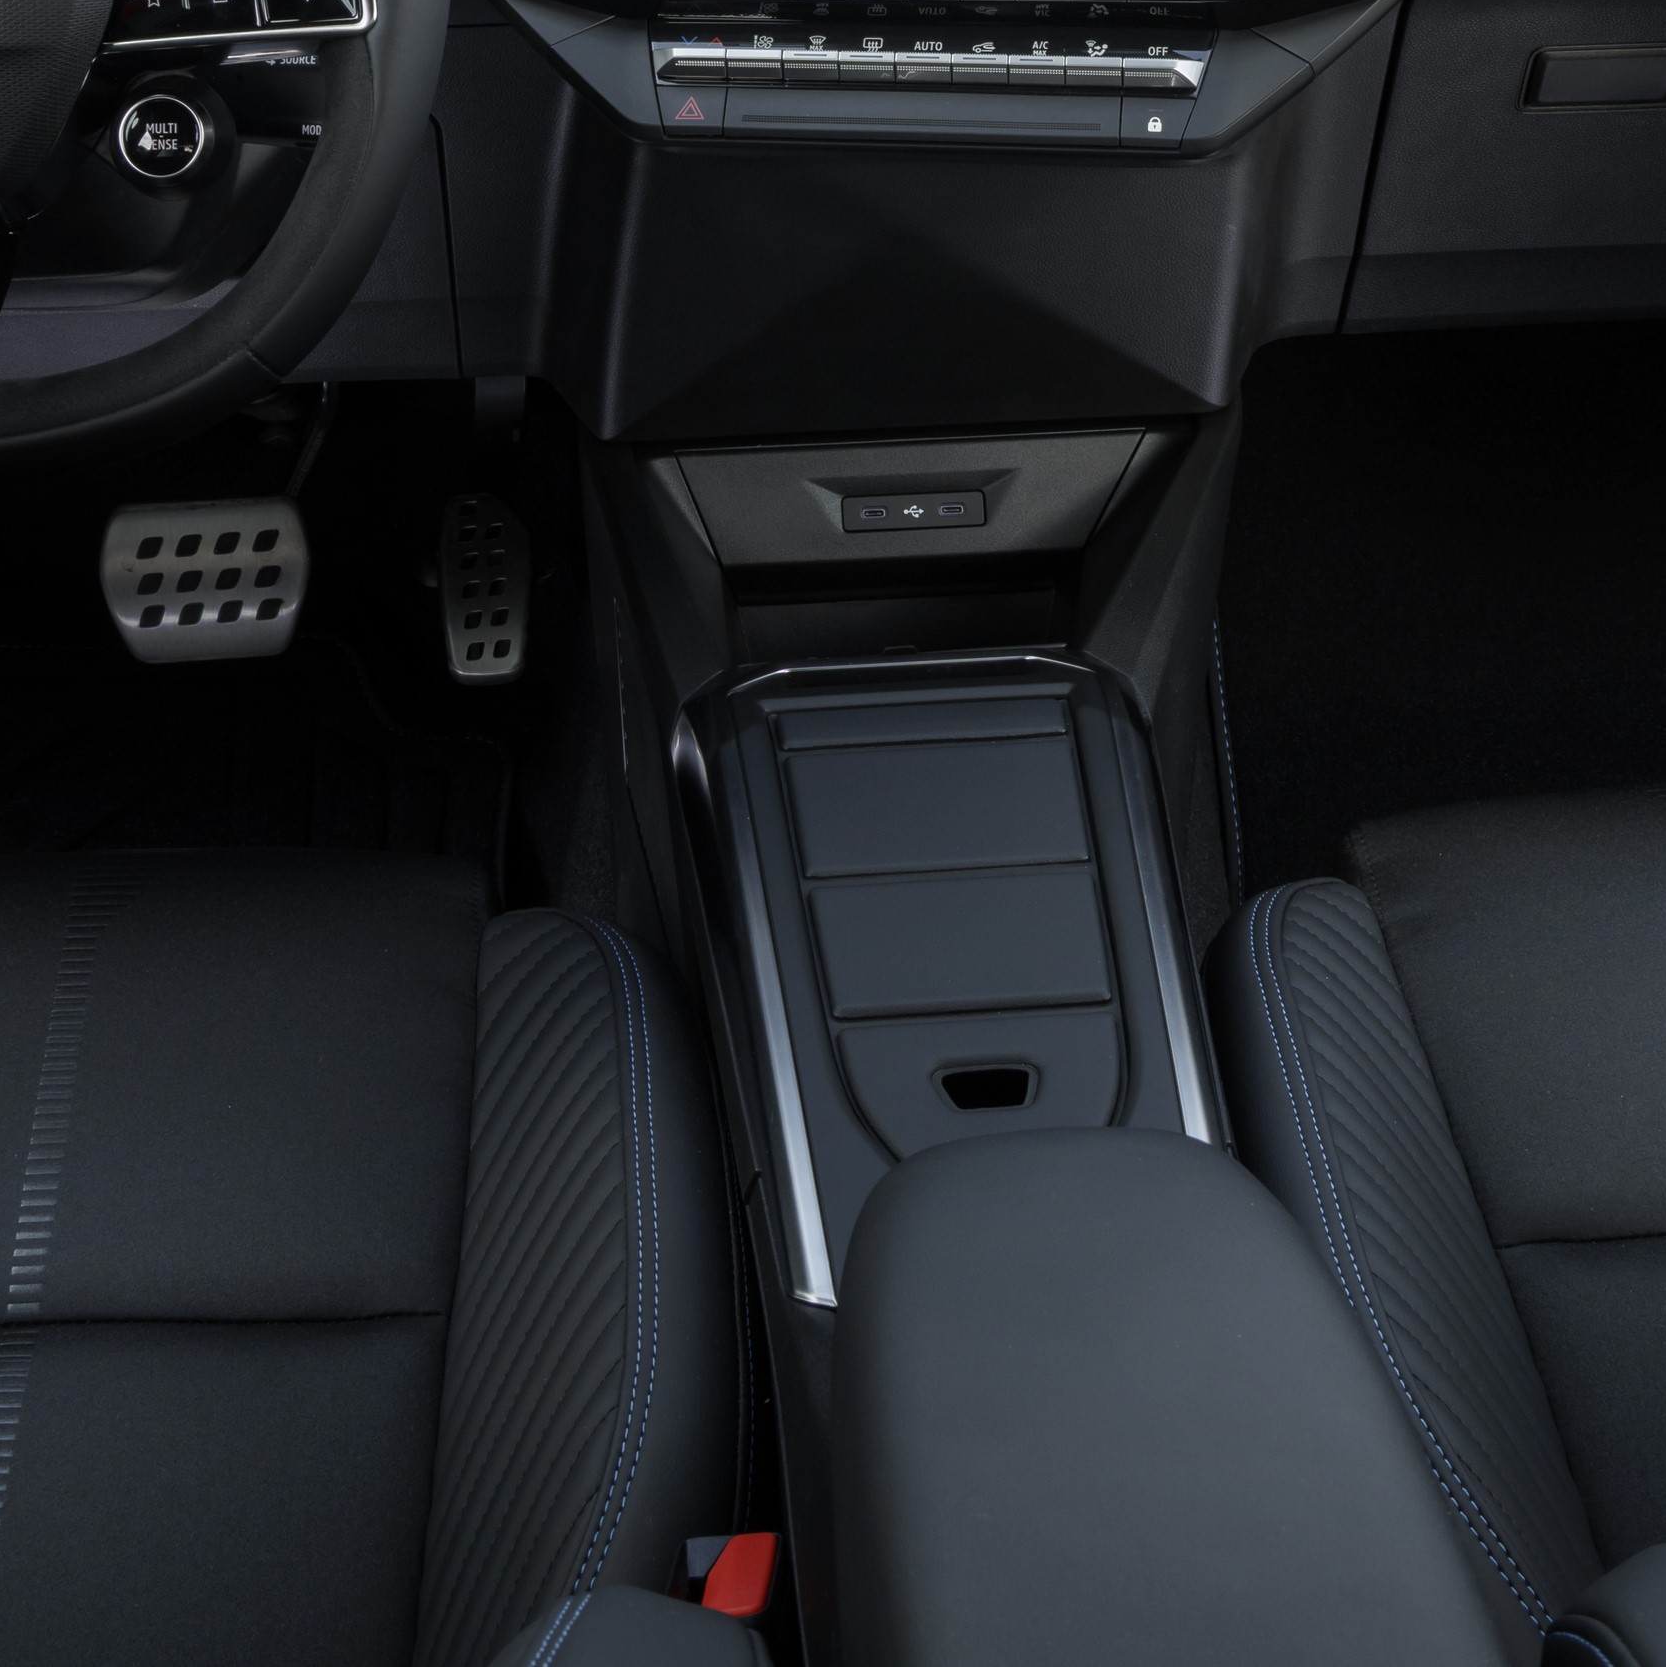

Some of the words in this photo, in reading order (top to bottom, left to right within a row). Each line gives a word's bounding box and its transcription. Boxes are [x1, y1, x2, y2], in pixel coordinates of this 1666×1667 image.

[914, 41, 943, 51] AUTO
[1032, 41, 1049, 50] A/C
[1147, 46, 1169, 56] OFF
[145, 123, 178, 134] MULTI
[301, 124, 322, 135] MOD
[148, 139, 178, 150] ENSE
